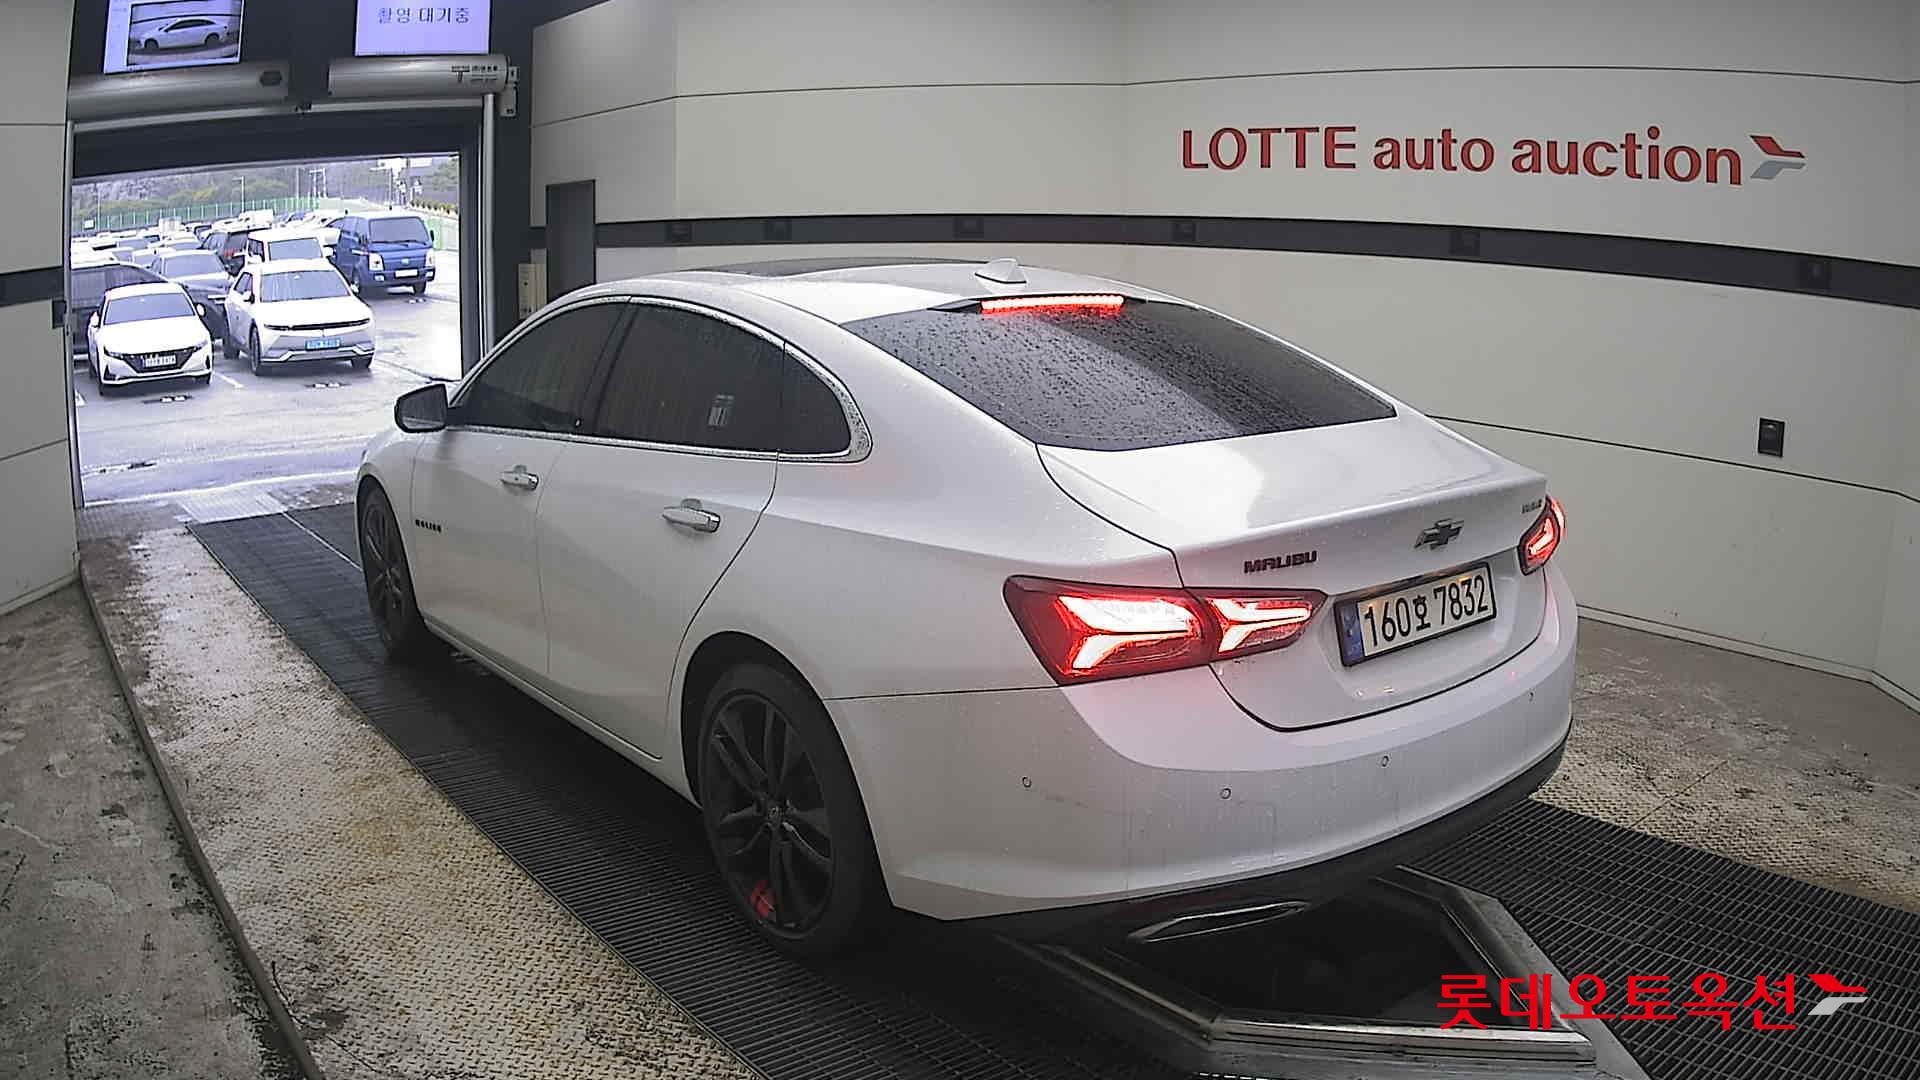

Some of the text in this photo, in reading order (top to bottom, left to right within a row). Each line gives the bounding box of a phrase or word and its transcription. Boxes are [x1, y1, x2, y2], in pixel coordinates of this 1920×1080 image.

[419, 7, 470, 25] 대기중
[1182, 125, 1742, 186] LOTTE auto auction
[1244, 550, 1317, 573] MALIBU
[1363, 574, 1489, 647] 160호 7832
